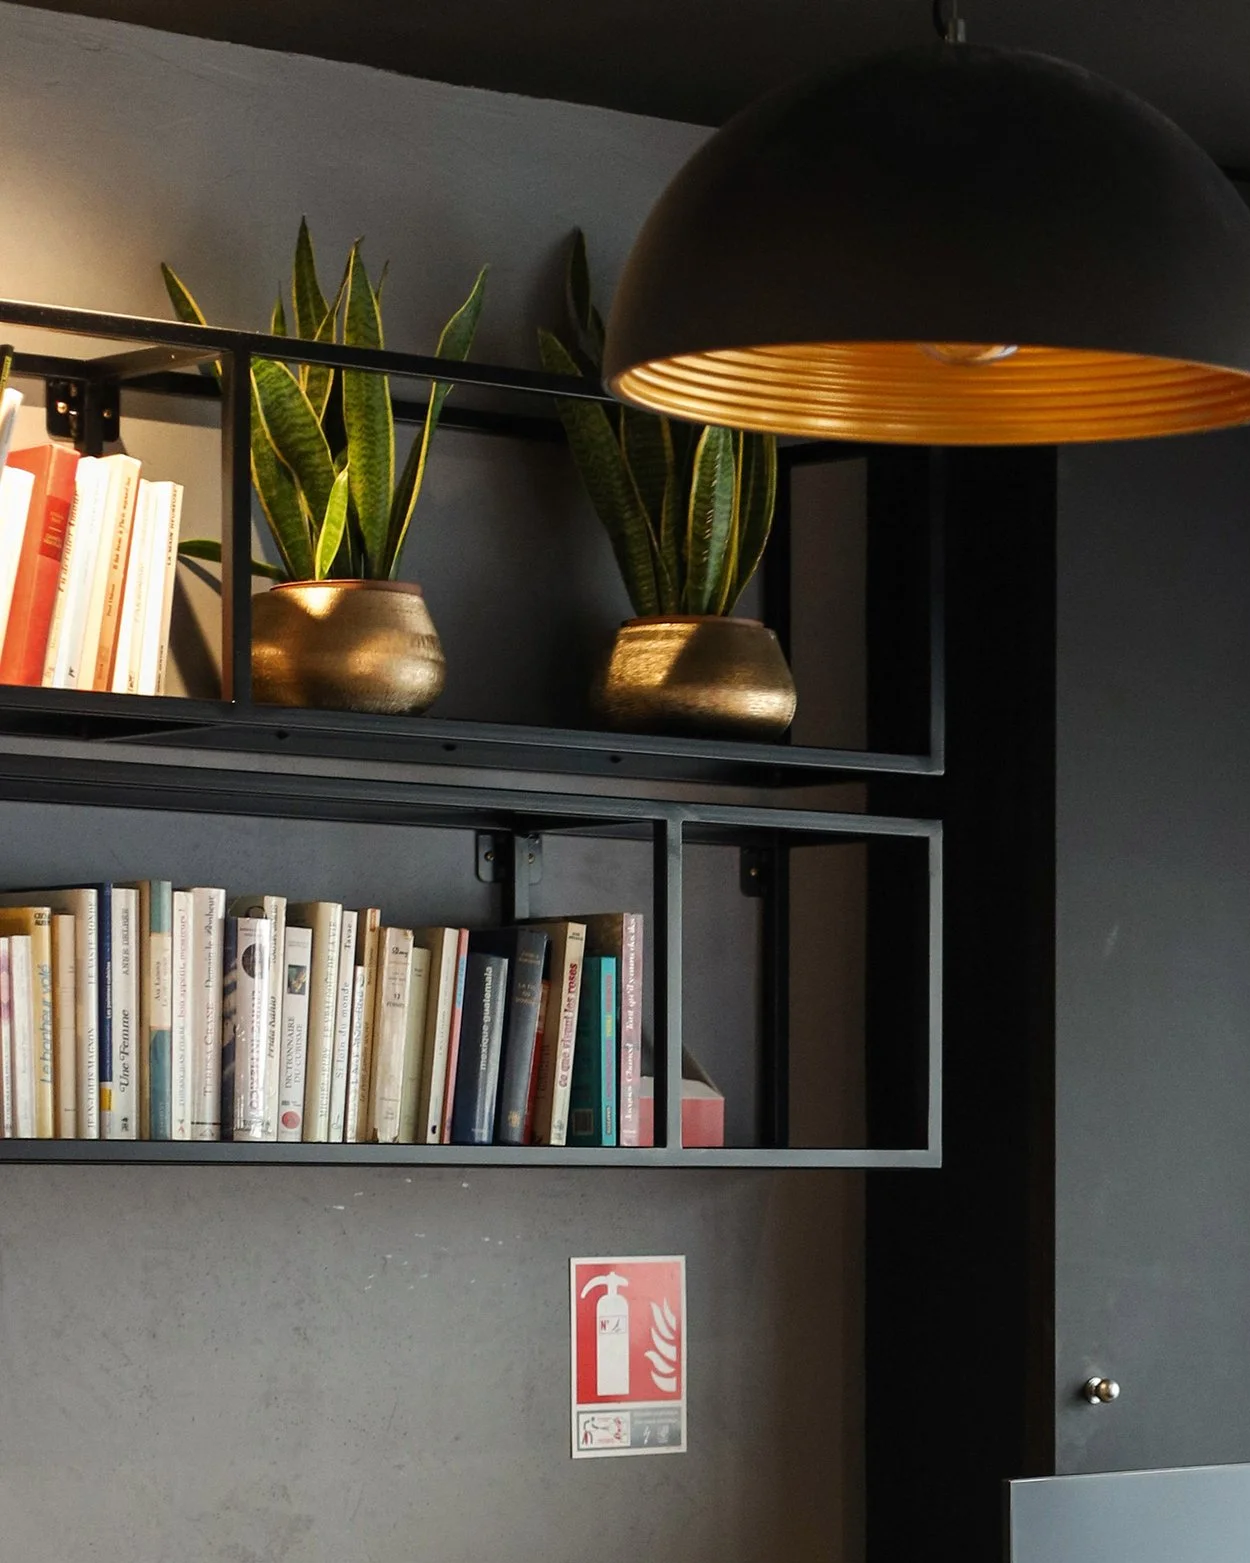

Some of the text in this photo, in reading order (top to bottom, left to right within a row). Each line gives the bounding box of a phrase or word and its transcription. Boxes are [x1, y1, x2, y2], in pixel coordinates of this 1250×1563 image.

[87, 900, 95, 935] MONDE
[567, 962, 578, 994] roses
[177, 1001, 185, 1018] bon
[341, 982, 350, 1017] monde
[562, 997, 575, 1013] les
[37, 964, 53, 1083] Le bonheur volé
[338, 1023, 346, 1036] du
[119, 1010, 130, 1092] Une Femme
[203, 1003, 214, 1096] TERESA CRANE
[284, 1016, 295, 1088] DICTIONNAIRE
[293, 1023, 303, 1083] DU CUBISME
[336, 1041, 345, 1062] loin
[560, 1052, 571, 1072] que
[335, 1068, 344, 1078] Si
